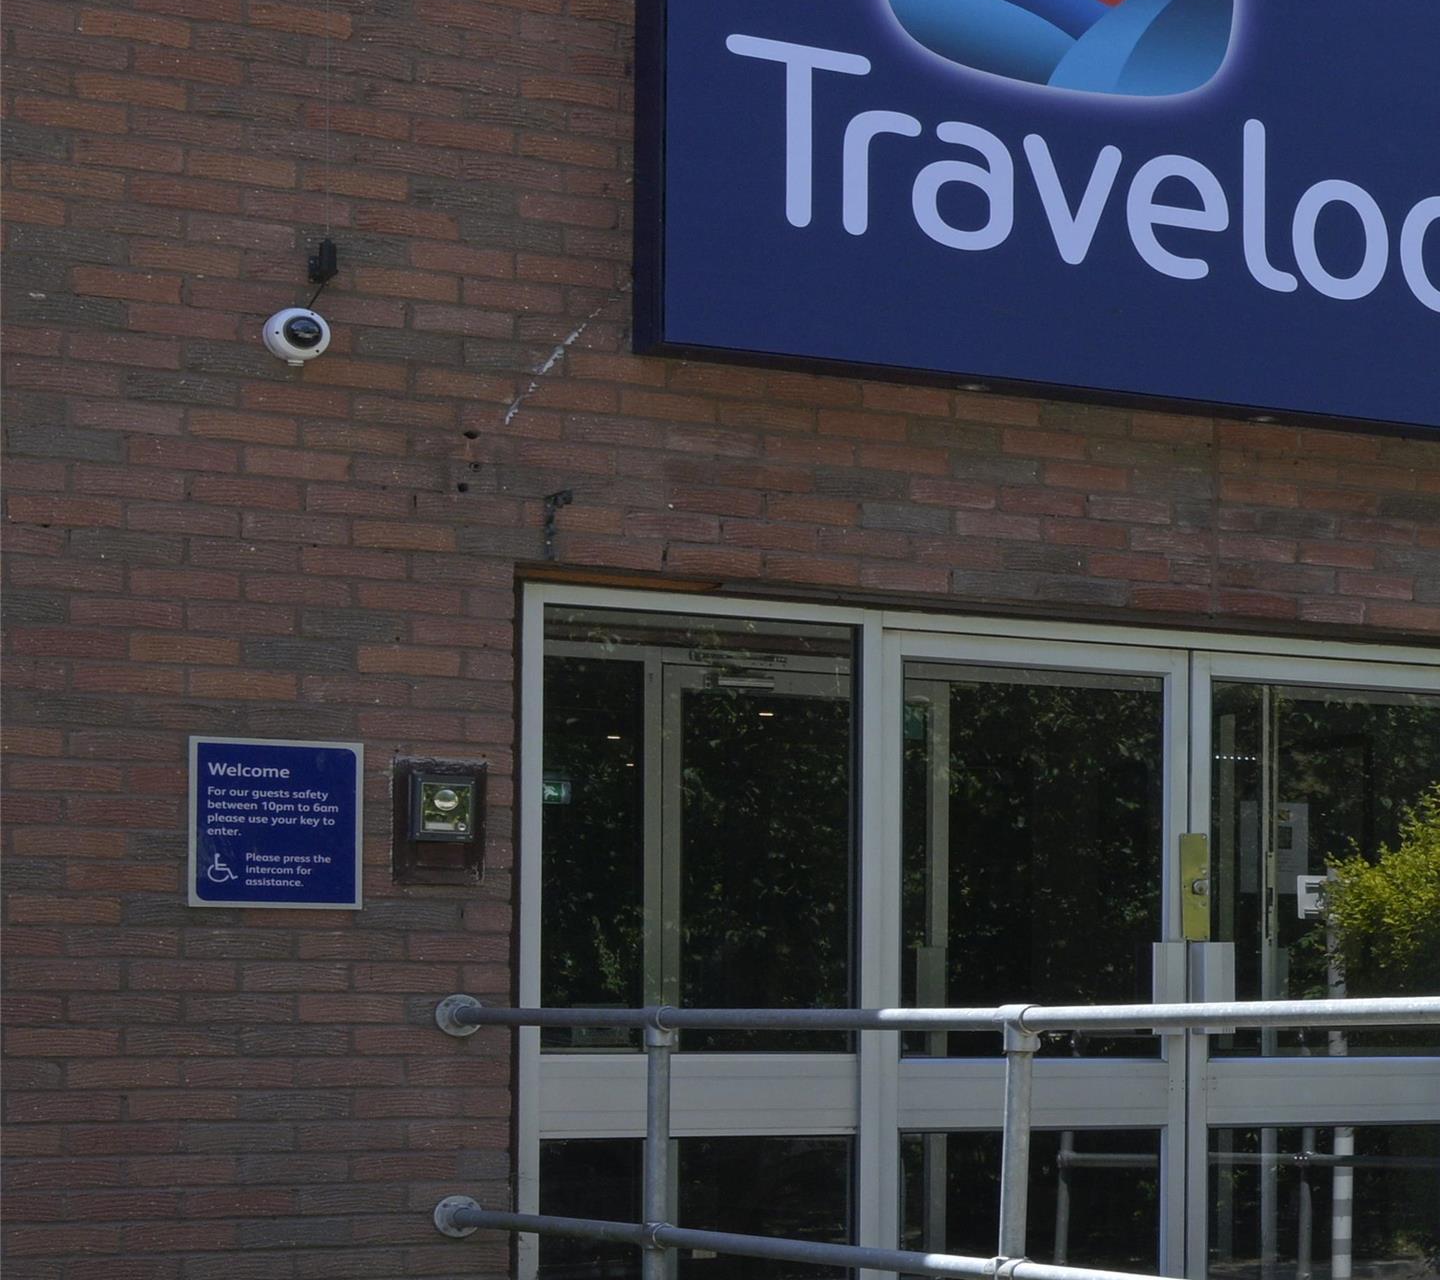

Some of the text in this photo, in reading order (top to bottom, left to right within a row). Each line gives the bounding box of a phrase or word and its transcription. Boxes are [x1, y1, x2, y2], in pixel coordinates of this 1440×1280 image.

[208, 762, 290, 778] Welcome
[207, 786, 226, 796] For
[252, 790, 290, 799] guests
[292, 789, 328, 801] safety
[207, 799, 339, 813] between 10pm to 6am
[207, 812, 335, 827] please use your key to
[207, 826, 242, 836] enter.
[245, 852, 331, 864] Please press the
[296, 866, 312, 875] for
[245, 877, 304, 887] assistance.
